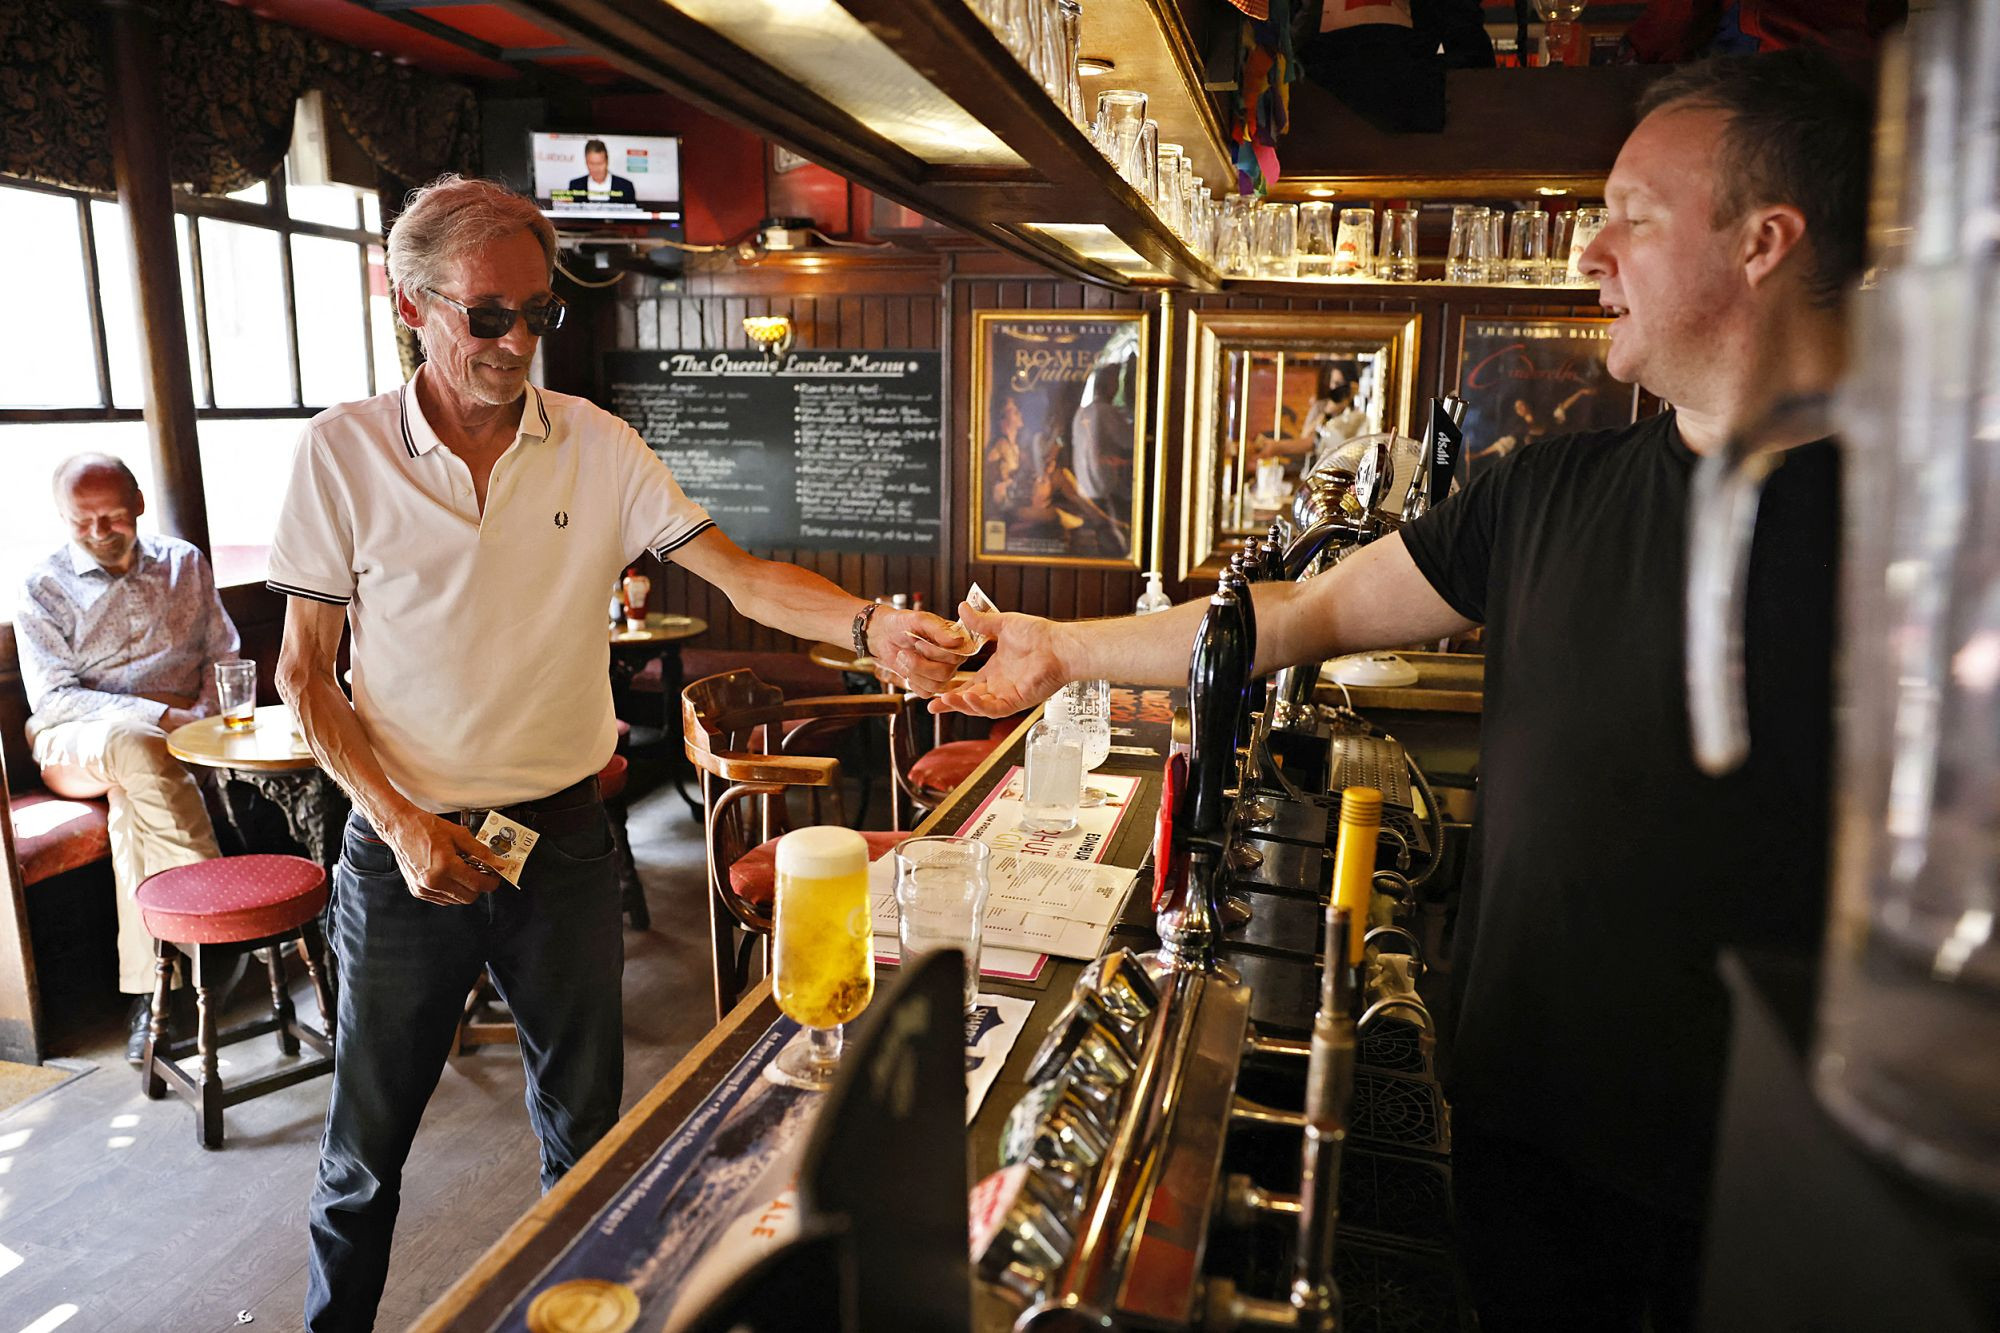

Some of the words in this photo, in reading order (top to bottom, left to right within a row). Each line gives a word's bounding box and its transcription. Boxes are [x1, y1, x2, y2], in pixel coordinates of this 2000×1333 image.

[538, 152, 575, 163] Labour
[1027, 325, 1071, 334] ROYAL
[1080, 325, 1117, 335] BALL
[1477, 326, 1504, 336] THE
[1513, 327, 1561, 338] ROYAL
[1569, 328, 1612, 339] BALL
[671, 354, 708, 372] The
[783, 354, 844, 372] Larder
[844, 354, 905, 372] Menu
[1436, 431, 1451, 465] Asahi
[990, 834, 1023, 850] GIN
[1073, 833, 1102, 861] EDINBUR
[965, 1008, 989, 1043] SHARP'
[751, 1200, 792, 1239] ALE
